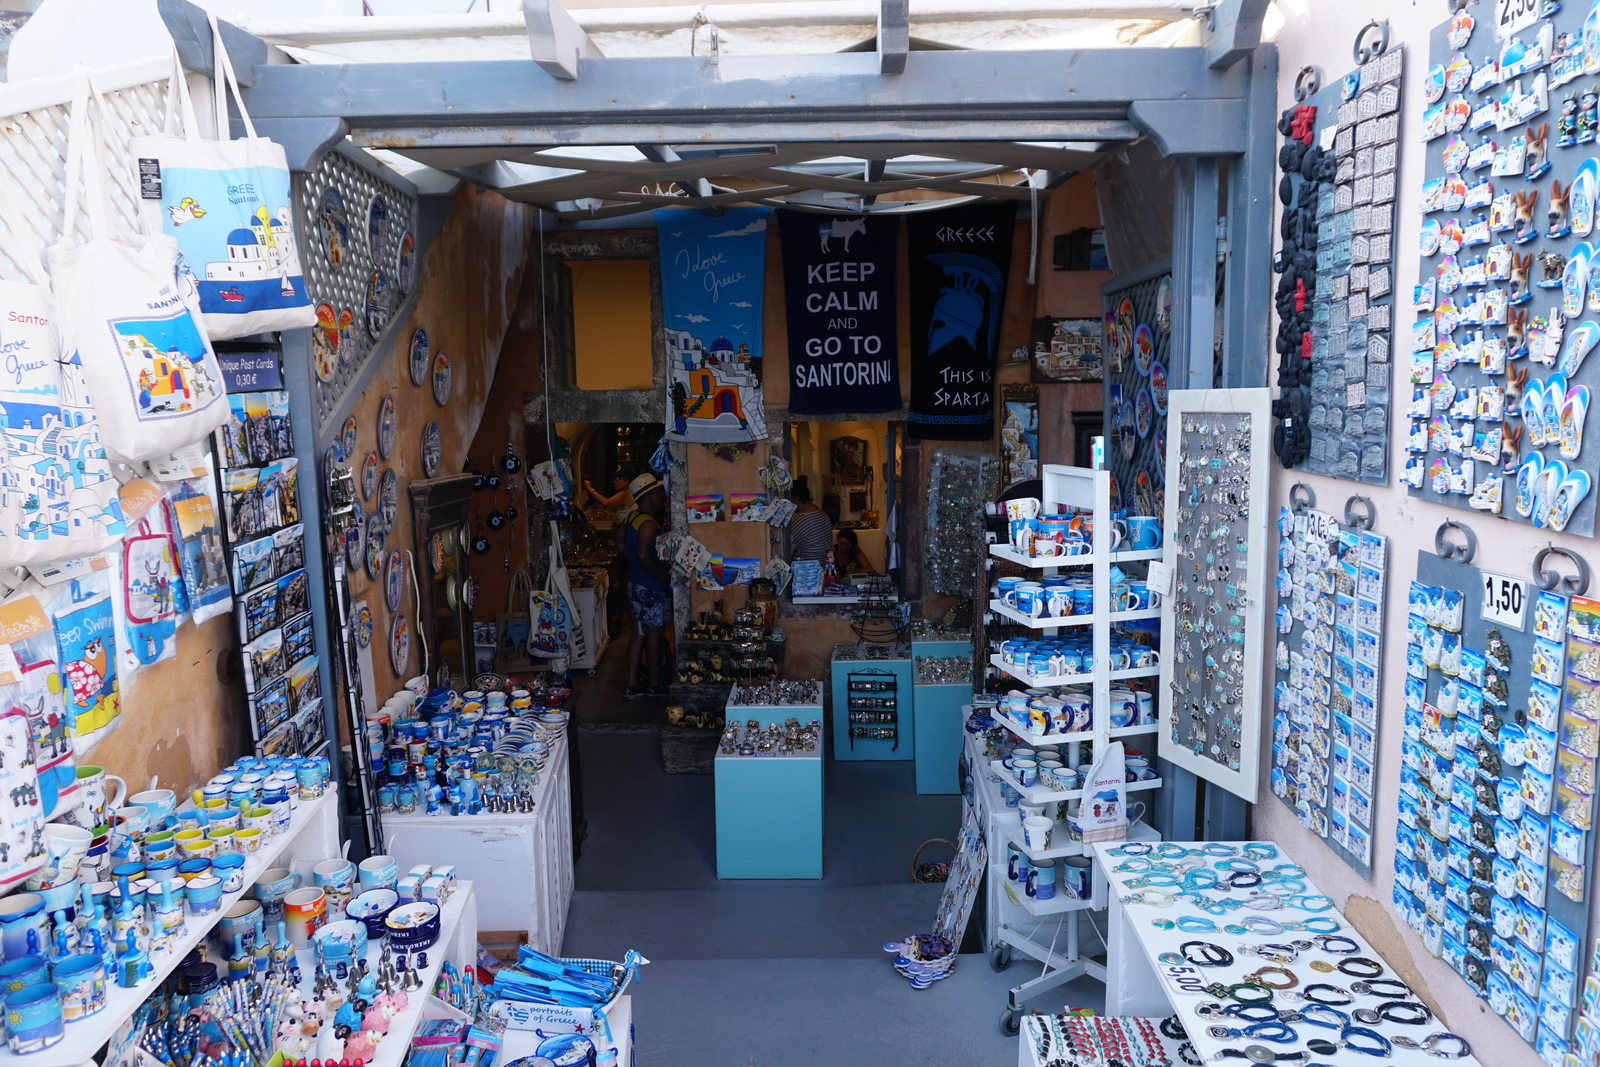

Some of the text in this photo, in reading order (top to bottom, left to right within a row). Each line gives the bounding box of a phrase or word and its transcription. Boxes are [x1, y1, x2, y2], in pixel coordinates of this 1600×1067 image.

[935, 225, 995, 243] GREECE
[807, 261, 876, 285] KEEP
[703, 270, 746, 303] Greece
[806, 290, 878, 313] CALM
[827, 317, 858, 331] AND
[805, 335, 882, 357] GO TO
[5, 354, 49, 385] Greece
[220, 357, 274, 373] Unique Post Cards
[795, 359, 892, 388] SANTORINI
[235, 373, 257, 387] 0,30 €
[1485, 576, 1522, 615] 1,50
[59, 626, 82, 646] eep
[1094, 778, 1121, 787] Santorini
[391, 939, 431, 950] SANTORINI
[1166, 966, 1207, 992] 5,00
[529, 1007, 573, 1016] portraits
[533, 1014, 579, 1025] of Greece
